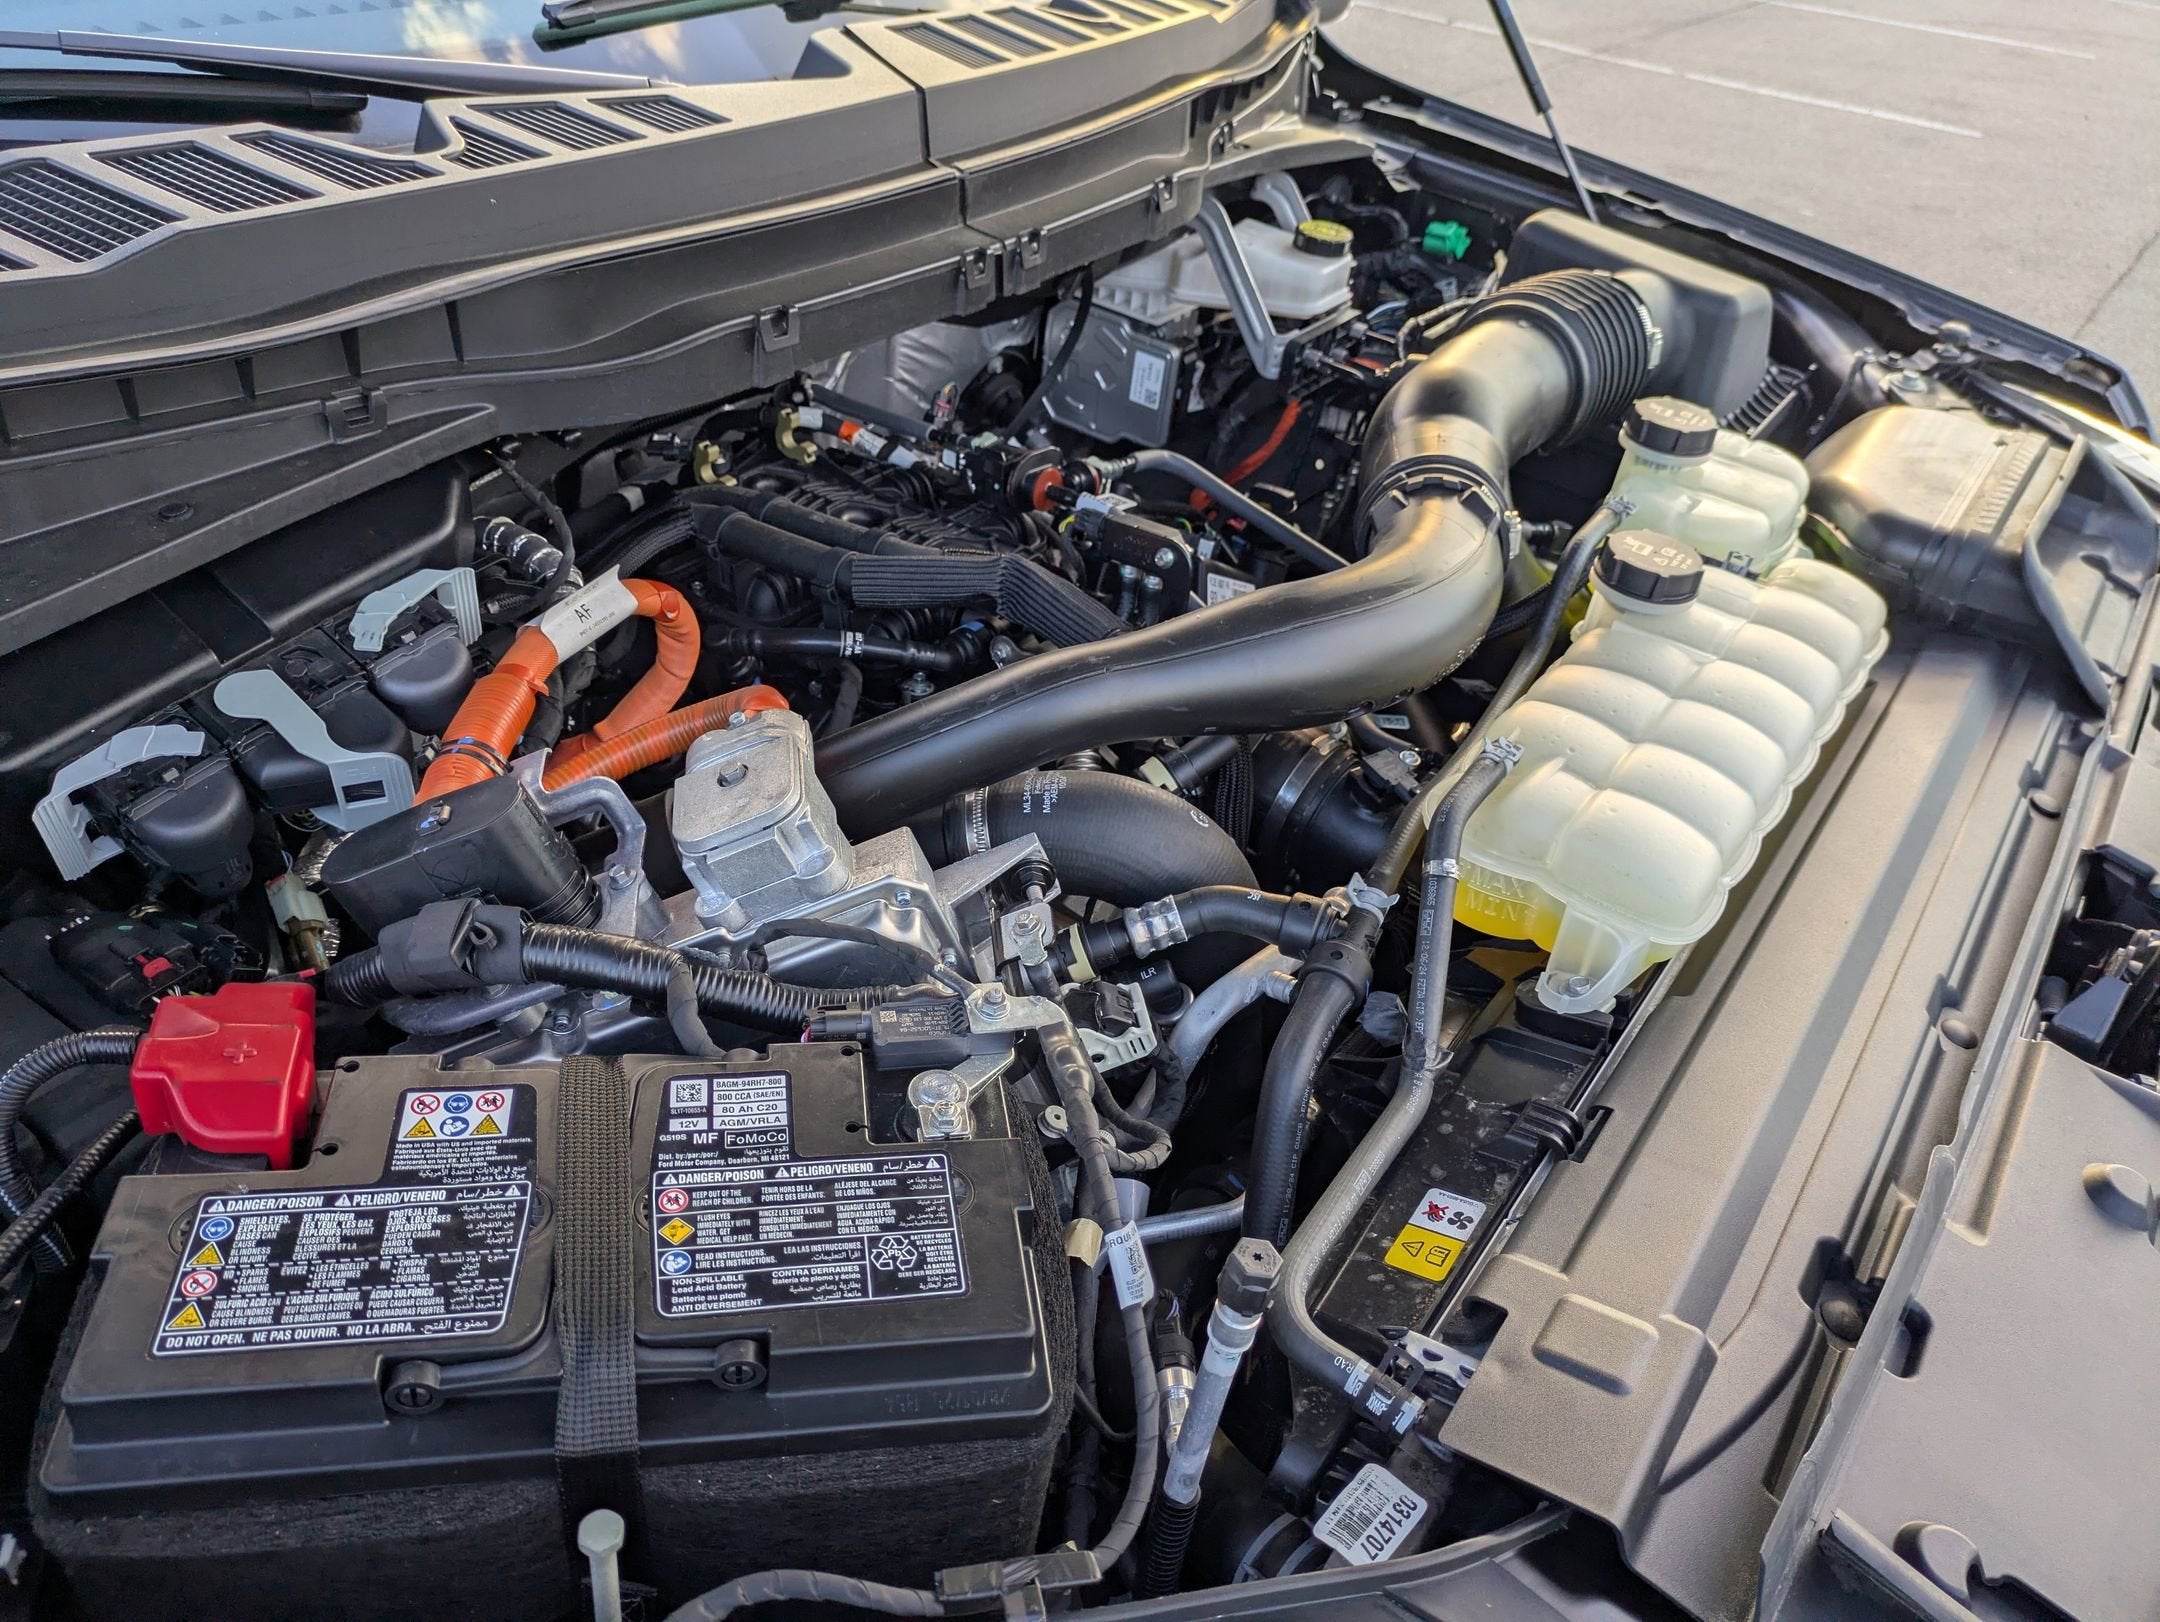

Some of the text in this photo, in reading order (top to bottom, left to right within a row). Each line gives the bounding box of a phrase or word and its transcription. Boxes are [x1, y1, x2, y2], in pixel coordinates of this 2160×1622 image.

[574, 603, 591, 623] AF
[1042, 791, 1050, 813] Made
[1470, 863, 1527, 902] MAX
[1140, 967, 1157, 980] ILR
[716, 1078, 781, 1088] BAGM-94RH7-800
[753, 1091, 783, 1099] (SAE/EN)
[679, 1120, 699, 1128] 12V
[720, 1116, 781, 1126] AGM/VRLA
[693, 1133, 718, 1144] MF
[727, 1132, 786, 1145] FoMoCo
[791, 1163, 873, 1177] PELIGRO/VENENO
[679, 1170, 764, 1184] DANGER/POISON
[353, 1190, 446, 1207] PELIGRO/VENENO
[456, 1188, 503, 1200] خطر/سام
[227, 1197, 324, 1211] DANGER/POISON
[314, 1212, 355, 1220] PROTÉGER
[389, 1209, 422, 1217] PROTEJA
[240, 1217, 267, 1225] SHIELD
[357, 1220, 374, 1228] GAZ
[238, 1224, 281, 1233] EXPLOSIVE
[385, 1223, 432, 1233] EXPLOSIVOS
[384, 1232, 413, 1240] PUEDEN
[233, 1240, 257, 1248] CAUSE
[295, 1244, 336, 1252] BLESSURES
[784, 1241, 863, 1254] LEA LAS INSTRUCCIONES.
[231, 1247, 271, 1256] BLINDNESS
[380, 1247, 415, 1255] CEGUERA.
[695, 1249, 766, 1260] READ INSTRUCTIONS.
[380, 1261, 390, 1269] NO
[695, 1261, 711, 1269] LIRE
[726, 1256, 777, 1266] INSTRUCTIONS.
[281, 1262, 369, 1275] ÉVITEZ LES ÉTINCELLES
[328, 1270, 360, 1278] FLAMMES
[397, 1267, 425, 1275] FLAMAS
[772, 1266, 860, 1278] CONTRA DERRAMES
[223, 1271, 235, 1279] NO
[239, 1276, 267, 1284] FLAMES
[396, 1275, 430, 1283] CIGARROS
[672, 1275, 744, 1285] NON-SPILLABLE
[322, 1279, 346, 1287] FUMER
[672, 1282, 747, 1294] Lead Acid Battery
[286, 1292, 360, 1305] L'ACIDE SULFURIQUE
[370, 1287, 434, 1300] ÁCIDO SULFÚRICO
[719, 1292, 746, 1301] plomb
[214, 1299, 249, 1309] SULFURIC
[250, 1298, 267, 1306] ACID
[390, 1299, 414, 1307] CAUSAR
[415, 1297, 444, 1305] CEGUERA
[671, 1299, 762, 1313] ANTI DÉVERSEMENT
[211, 1307, 274, 1318] CAUSE BLINDNESS
[373, 1308, 415, 1317] QUEMADURAS
[416, 1306, 446, 1314] FUERTES.
[220, 1318, 247, 1326] SEVERE
[249, 1316, 273, 1324] BURNS.
[347, 1323, 415, 1335] NO LA ABRA.
[166, 1334, 244, 1347] DO NOT OPEN.
[252, 1327, 340, 1343] NE PAS OUVRIR.
[1333, 1355, 1355, 1373] RAD
[1360, 1494, 1419, 1562] 0314707
